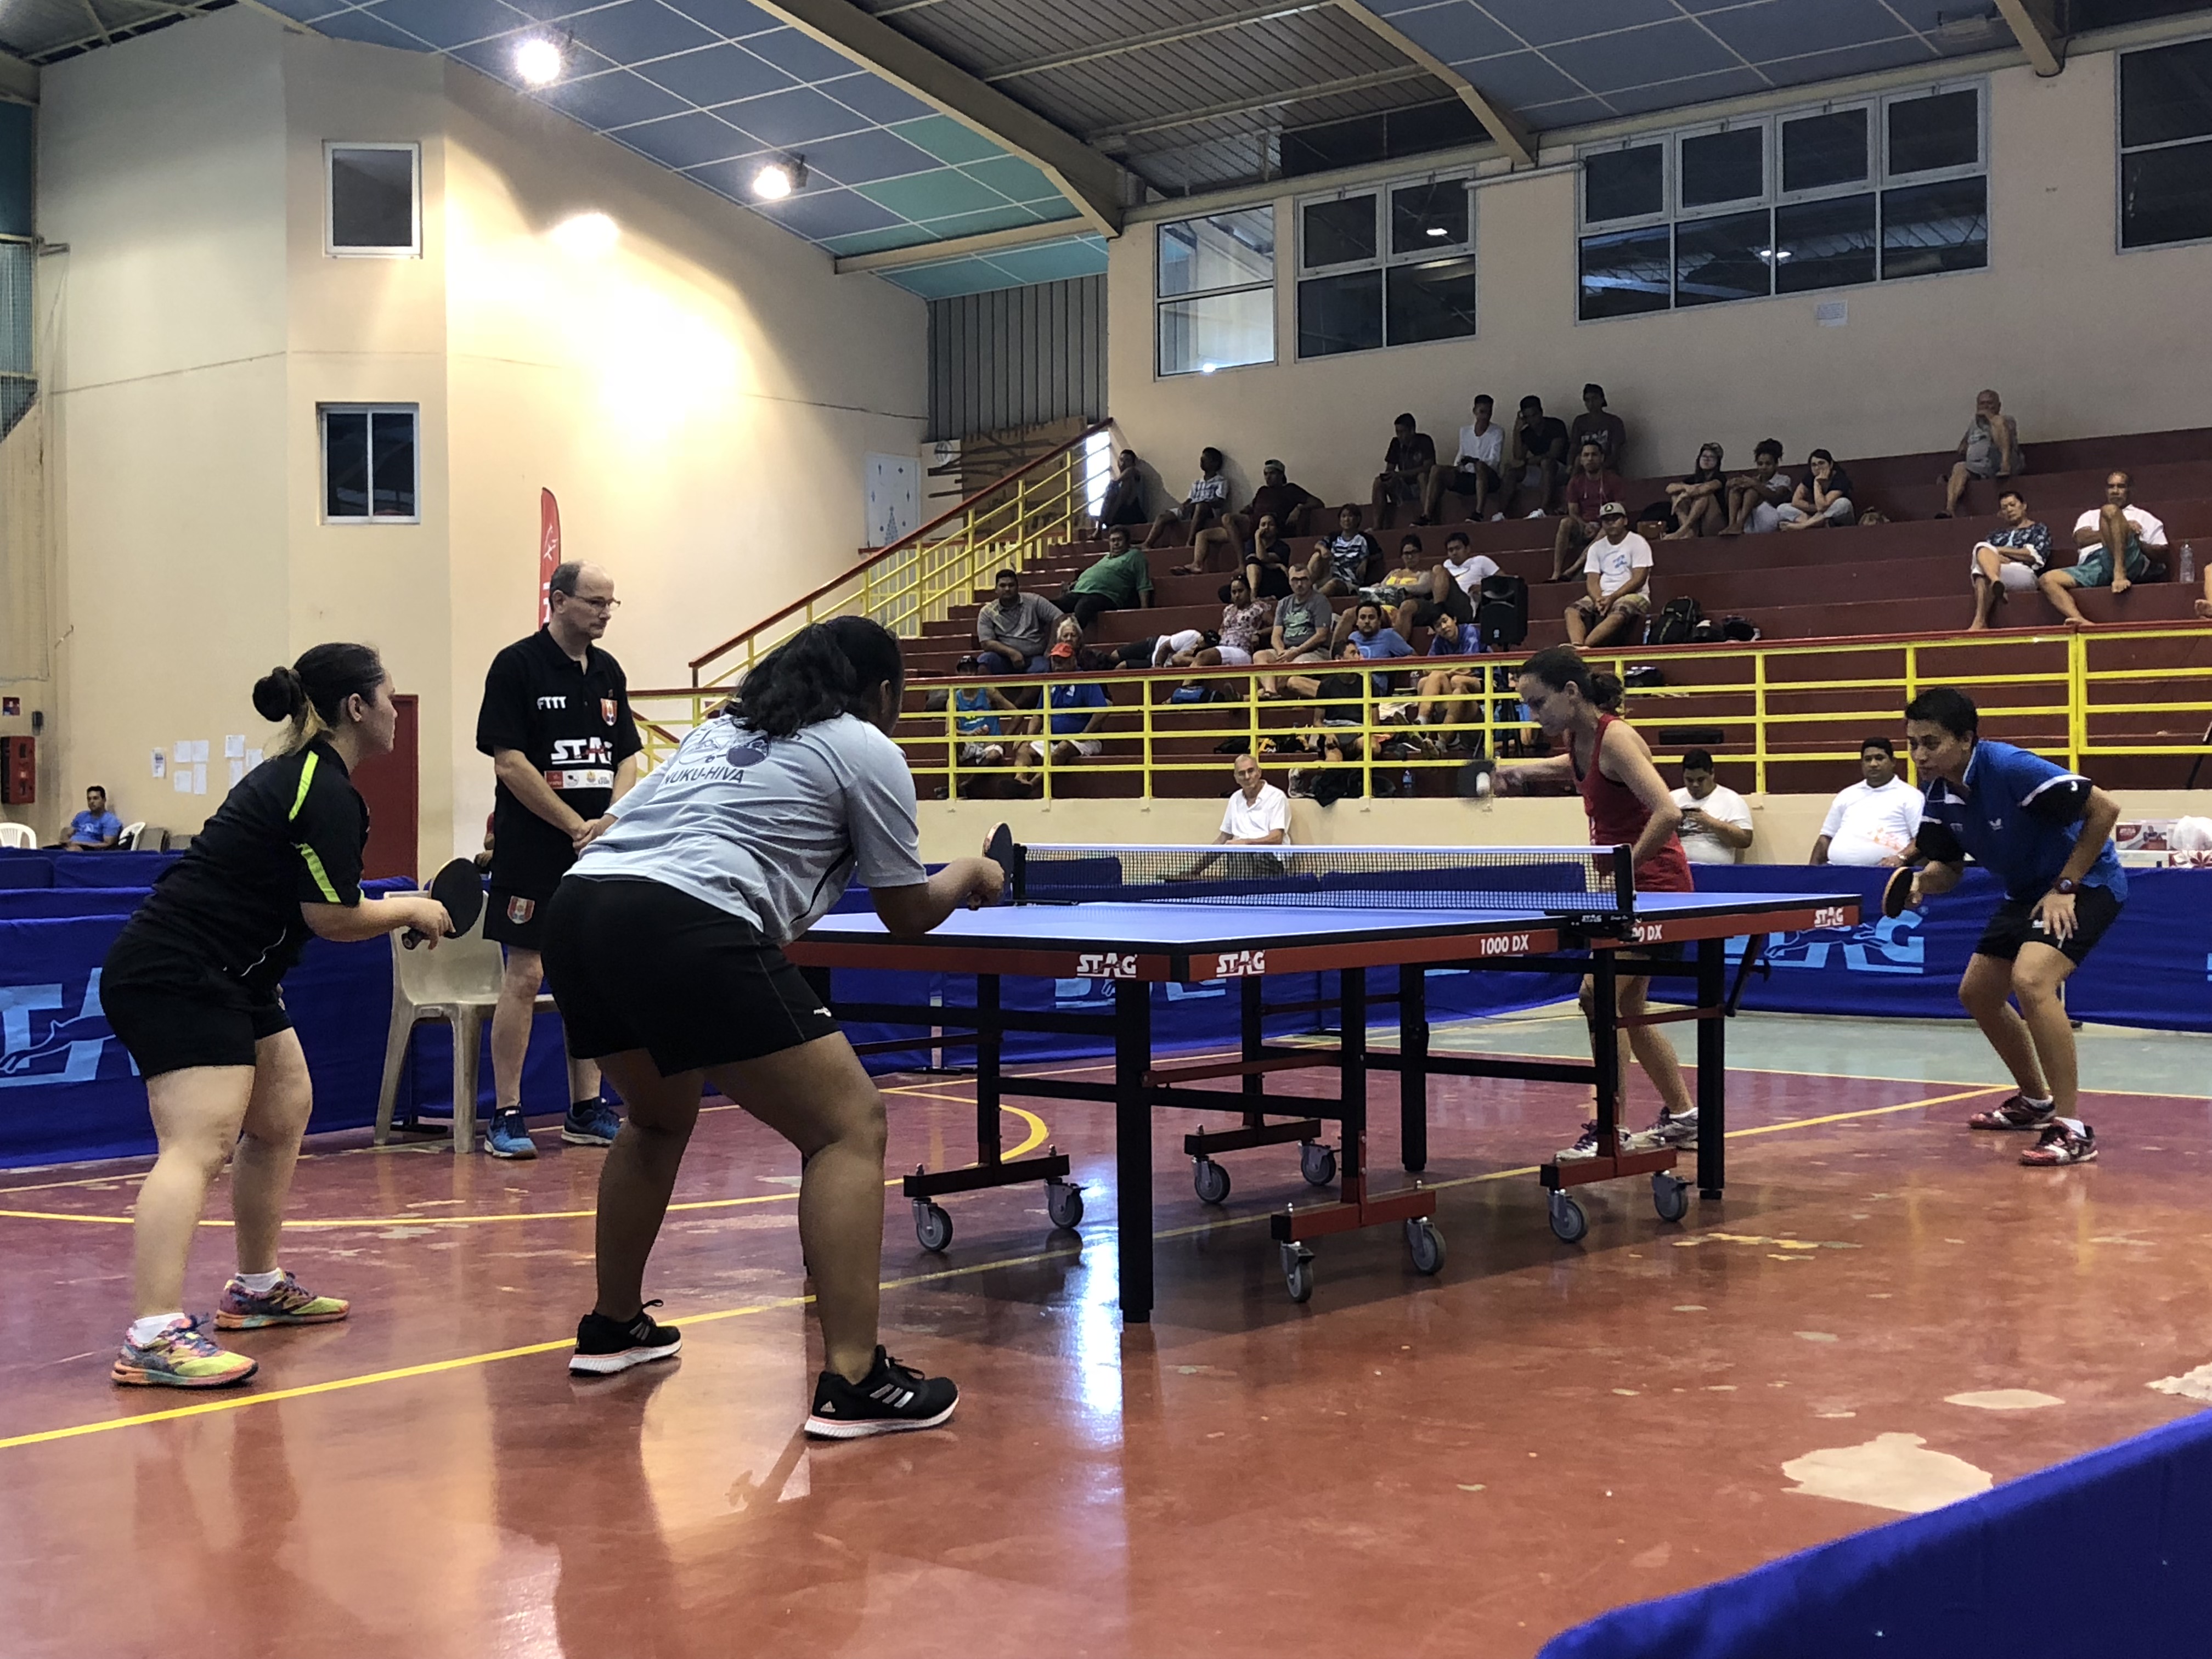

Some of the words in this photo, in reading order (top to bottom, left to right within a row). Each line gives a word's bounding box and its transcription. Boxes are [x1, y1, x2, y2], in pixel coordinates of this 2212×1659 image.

[537, 696, 566, 710] FTTT
[665, 766, 745, 784] NUKU-HIVA
[1814, 907, 1844, 927] STAG
[1647, 924, 1662, 940] DX
[1481, 936, 1509, 955] 1000
[1512, 934, 1529, 951] DX
[1077, 952, 1137, 978] STAG
[1216, 950, 1265, 977] STAG
